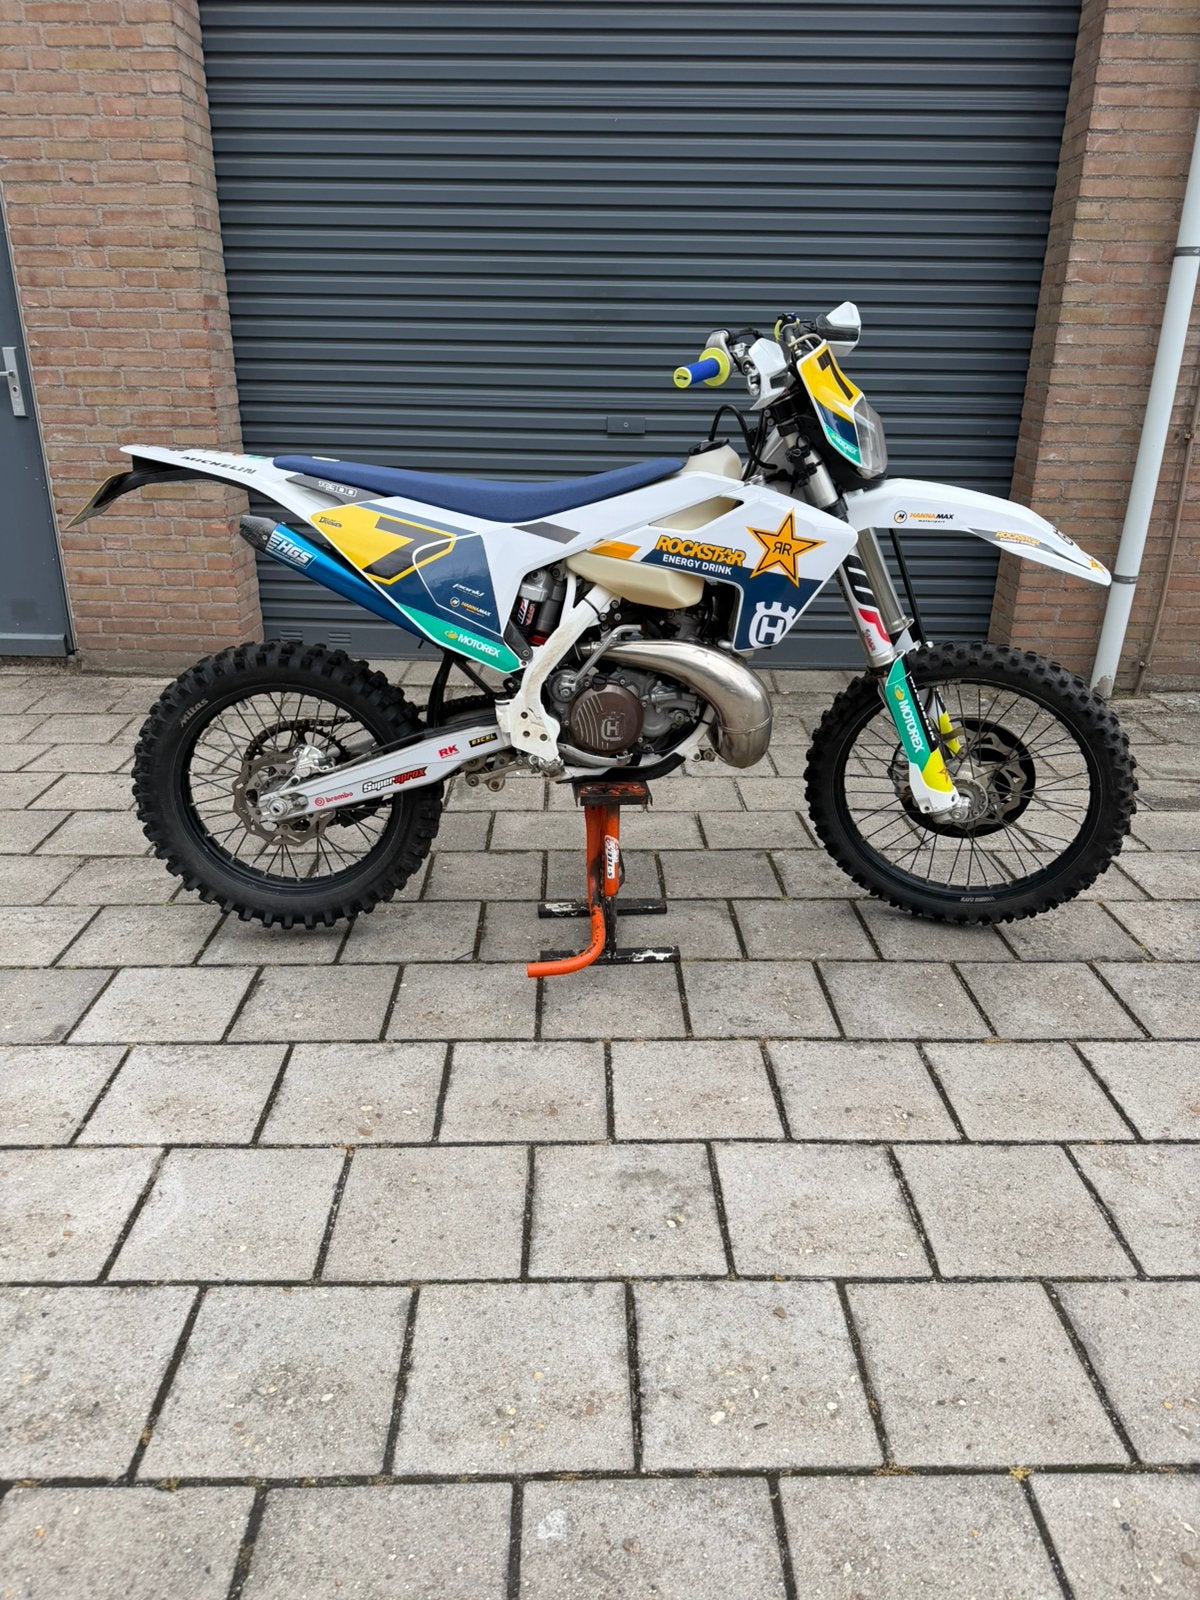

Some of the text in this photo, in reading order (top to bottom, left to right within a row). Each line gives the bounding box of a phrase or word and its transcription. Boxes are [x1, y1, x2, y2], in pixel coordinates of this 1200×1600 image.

[181, 455, 257, 474] MICHELIN
[276, 539, 313, 564] HGS
[655, 535, 747, 566] ROCKSTAR
[662, 554, 732, 576] ENERGY DRINK
[457, 633, 501, 658] MOTOREX
[898, 700, 925, 753] MOTOREX
[438, 744, 460, 758] RK
[325, 792, 354, 803] brembo
